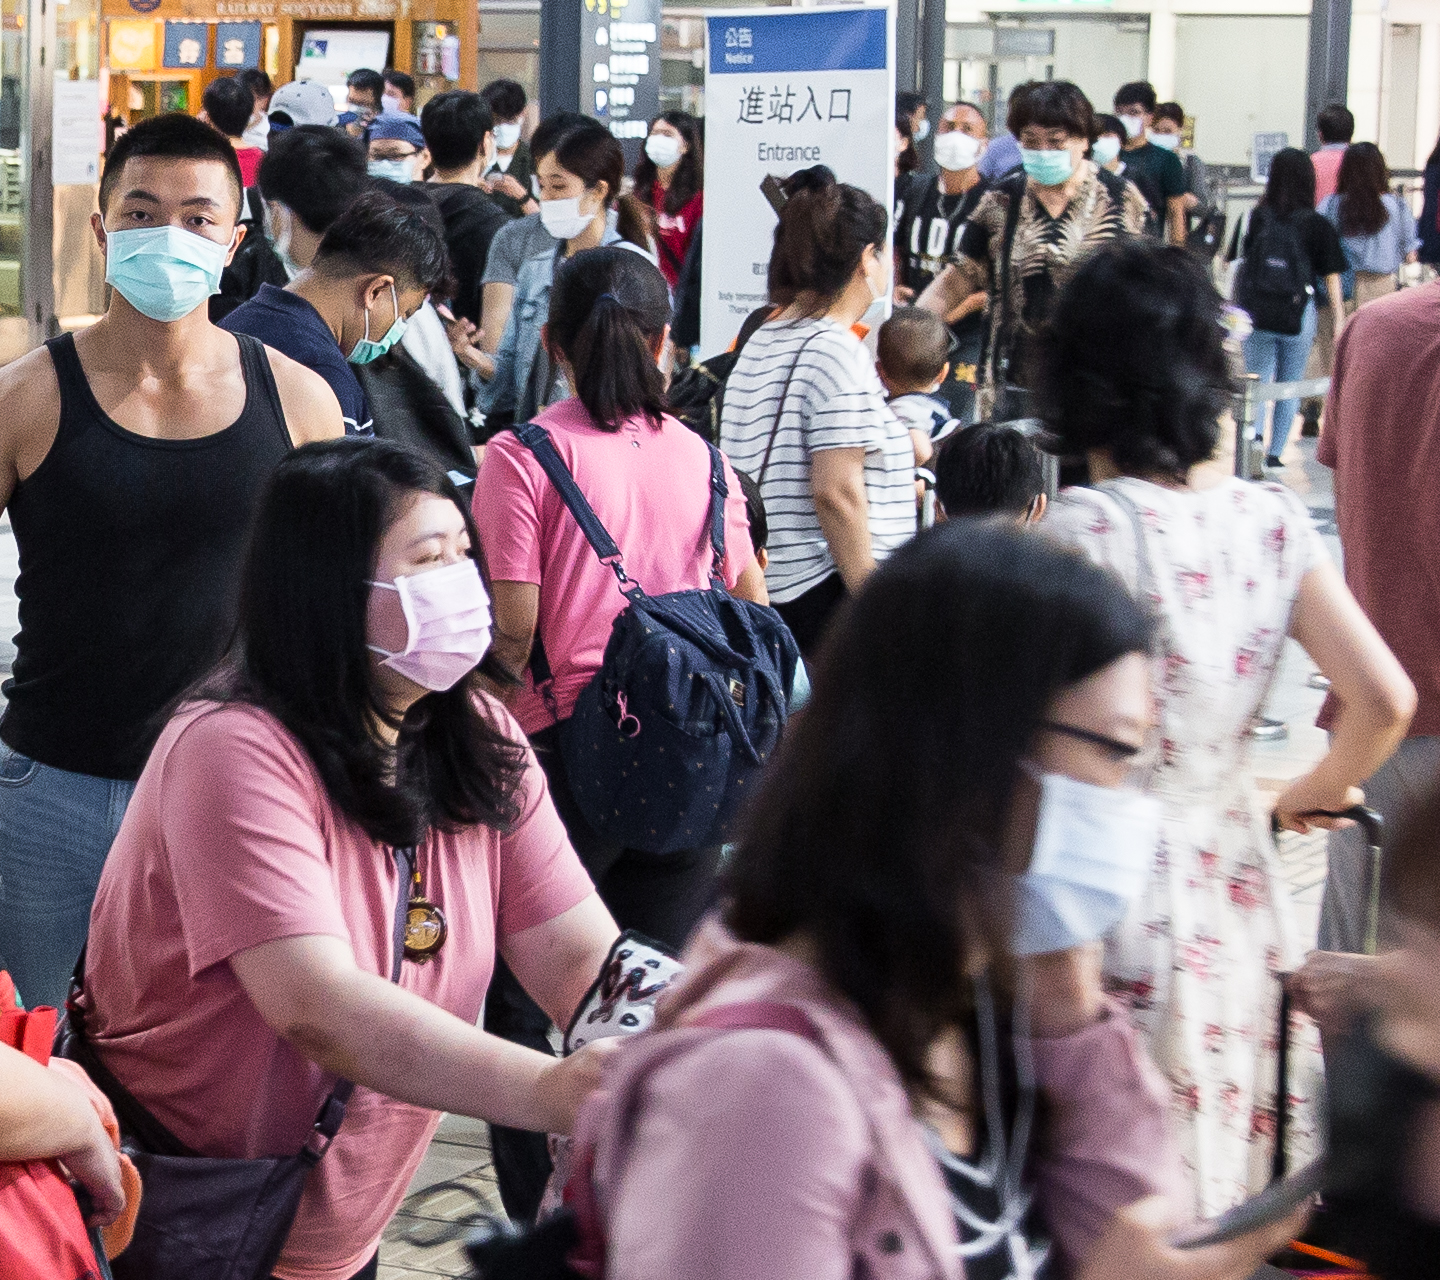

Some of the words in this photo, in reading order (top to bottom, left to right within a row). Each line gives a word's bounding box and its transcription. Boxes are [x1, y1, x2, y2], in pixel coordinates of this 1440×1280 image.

[725, 27, 753, 48] 公告
[725, 52, 754, 65] Notice
[737, 84, 851, 125] 進站入口
[757, 142, 821, 162] Entrance
